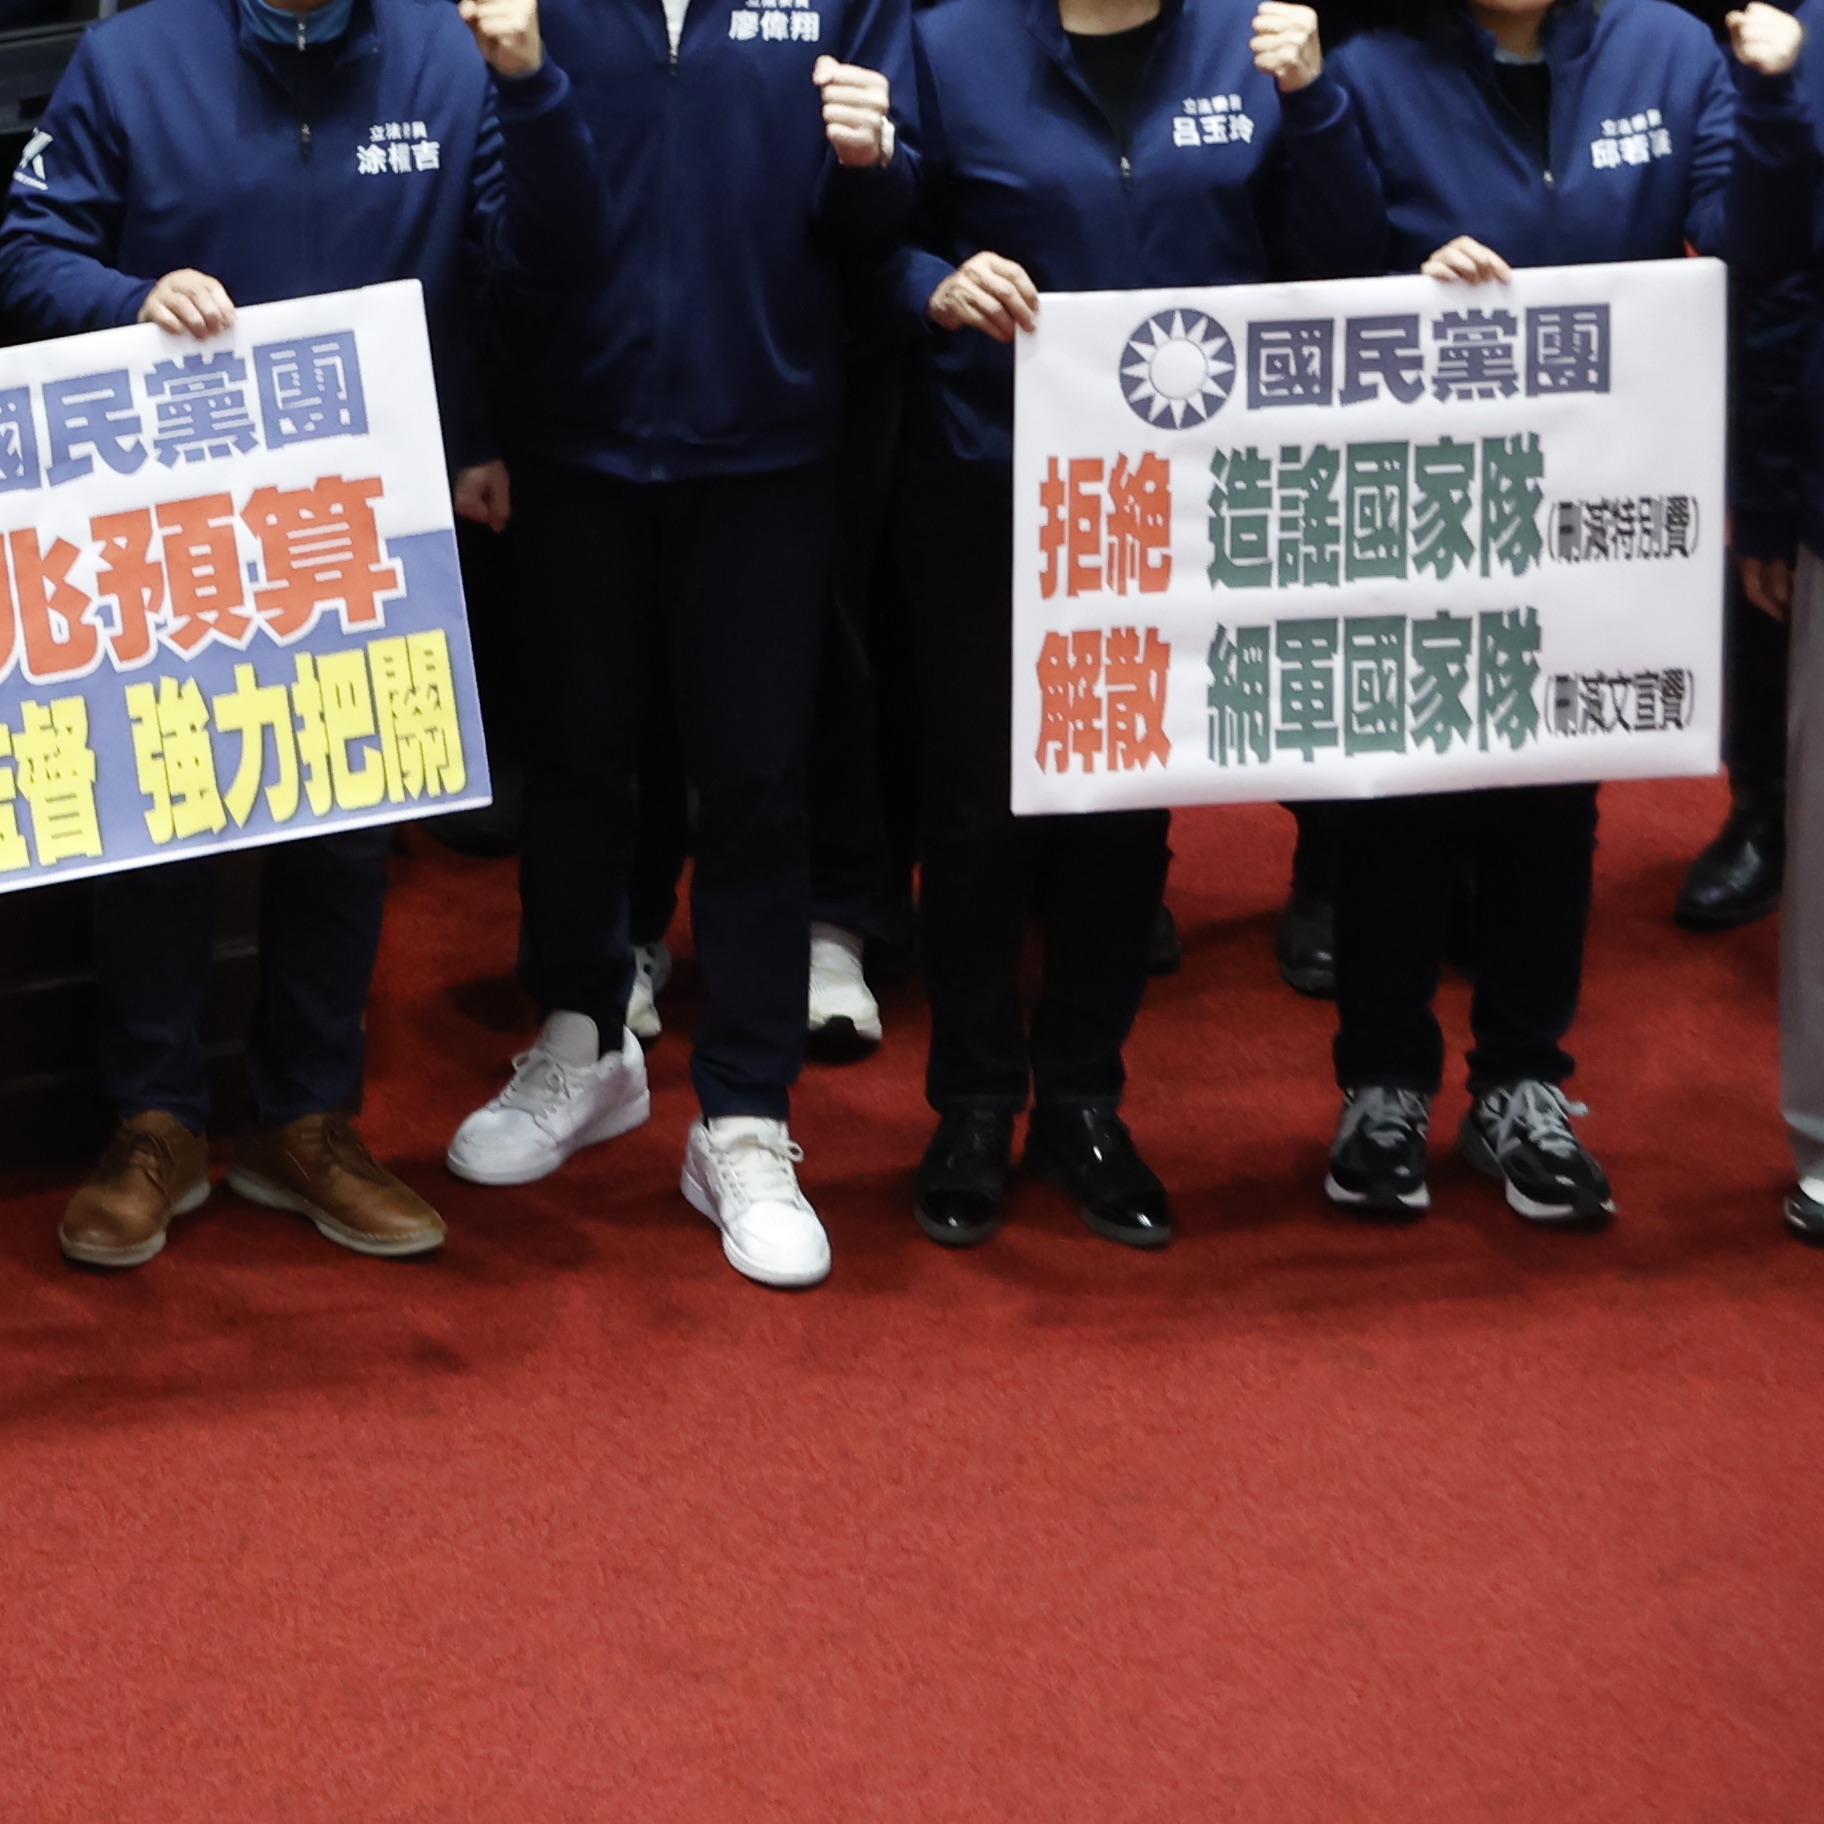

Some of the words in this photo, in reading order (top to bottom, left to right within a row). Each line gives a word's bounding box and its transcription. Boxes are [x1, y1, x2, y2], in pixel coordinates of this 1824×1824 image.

[355, 140, 441, 175] 涂權吉
[1171, 114, 1254, 148] 呂玉玲
[1247, 302, 1611, 410] 國民黨團
[1039, 450, 1172, 600] 拒絕
[1207, 432, 1545, 591] 造謠國家隊
[125, 628, 467, 844] 強力把關
[1034, 625, 1172, 775] 解散
[1206, 606, 1543, 768] 網軍國家隊
